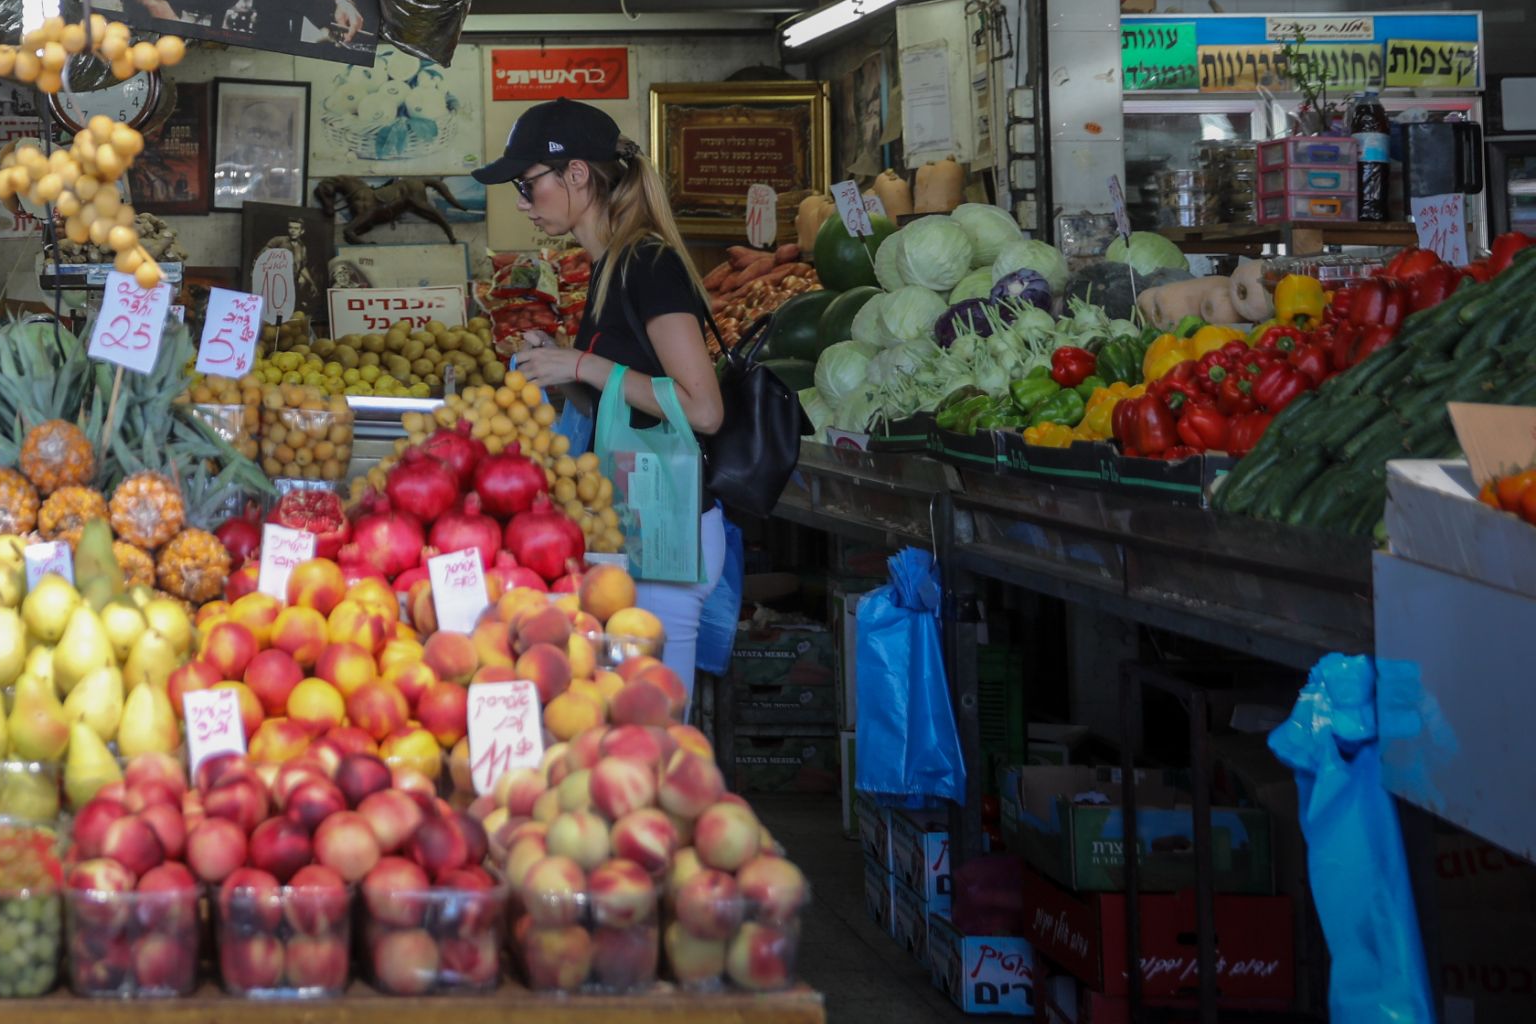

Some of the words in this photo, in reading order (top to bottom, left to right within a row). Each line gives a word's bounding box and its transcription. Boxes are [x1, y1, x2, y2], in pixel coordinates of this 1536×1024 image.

[1122, 27, 1179, 50] עוגות
[1126, 61, 1195, 88] יומולד
[1388, 43, 1478, 85] קצפות
[262, 271, 288, 315] 10
[99, 315, 152, 350] 25
[363, 314, 391, 330] כל
[205, 328, 235, 364] 5
[764, 651, 797, 659] MESIKA
[735, 756, 768, 764] BATATA
[769, 757, 803, 765] MESIKA
